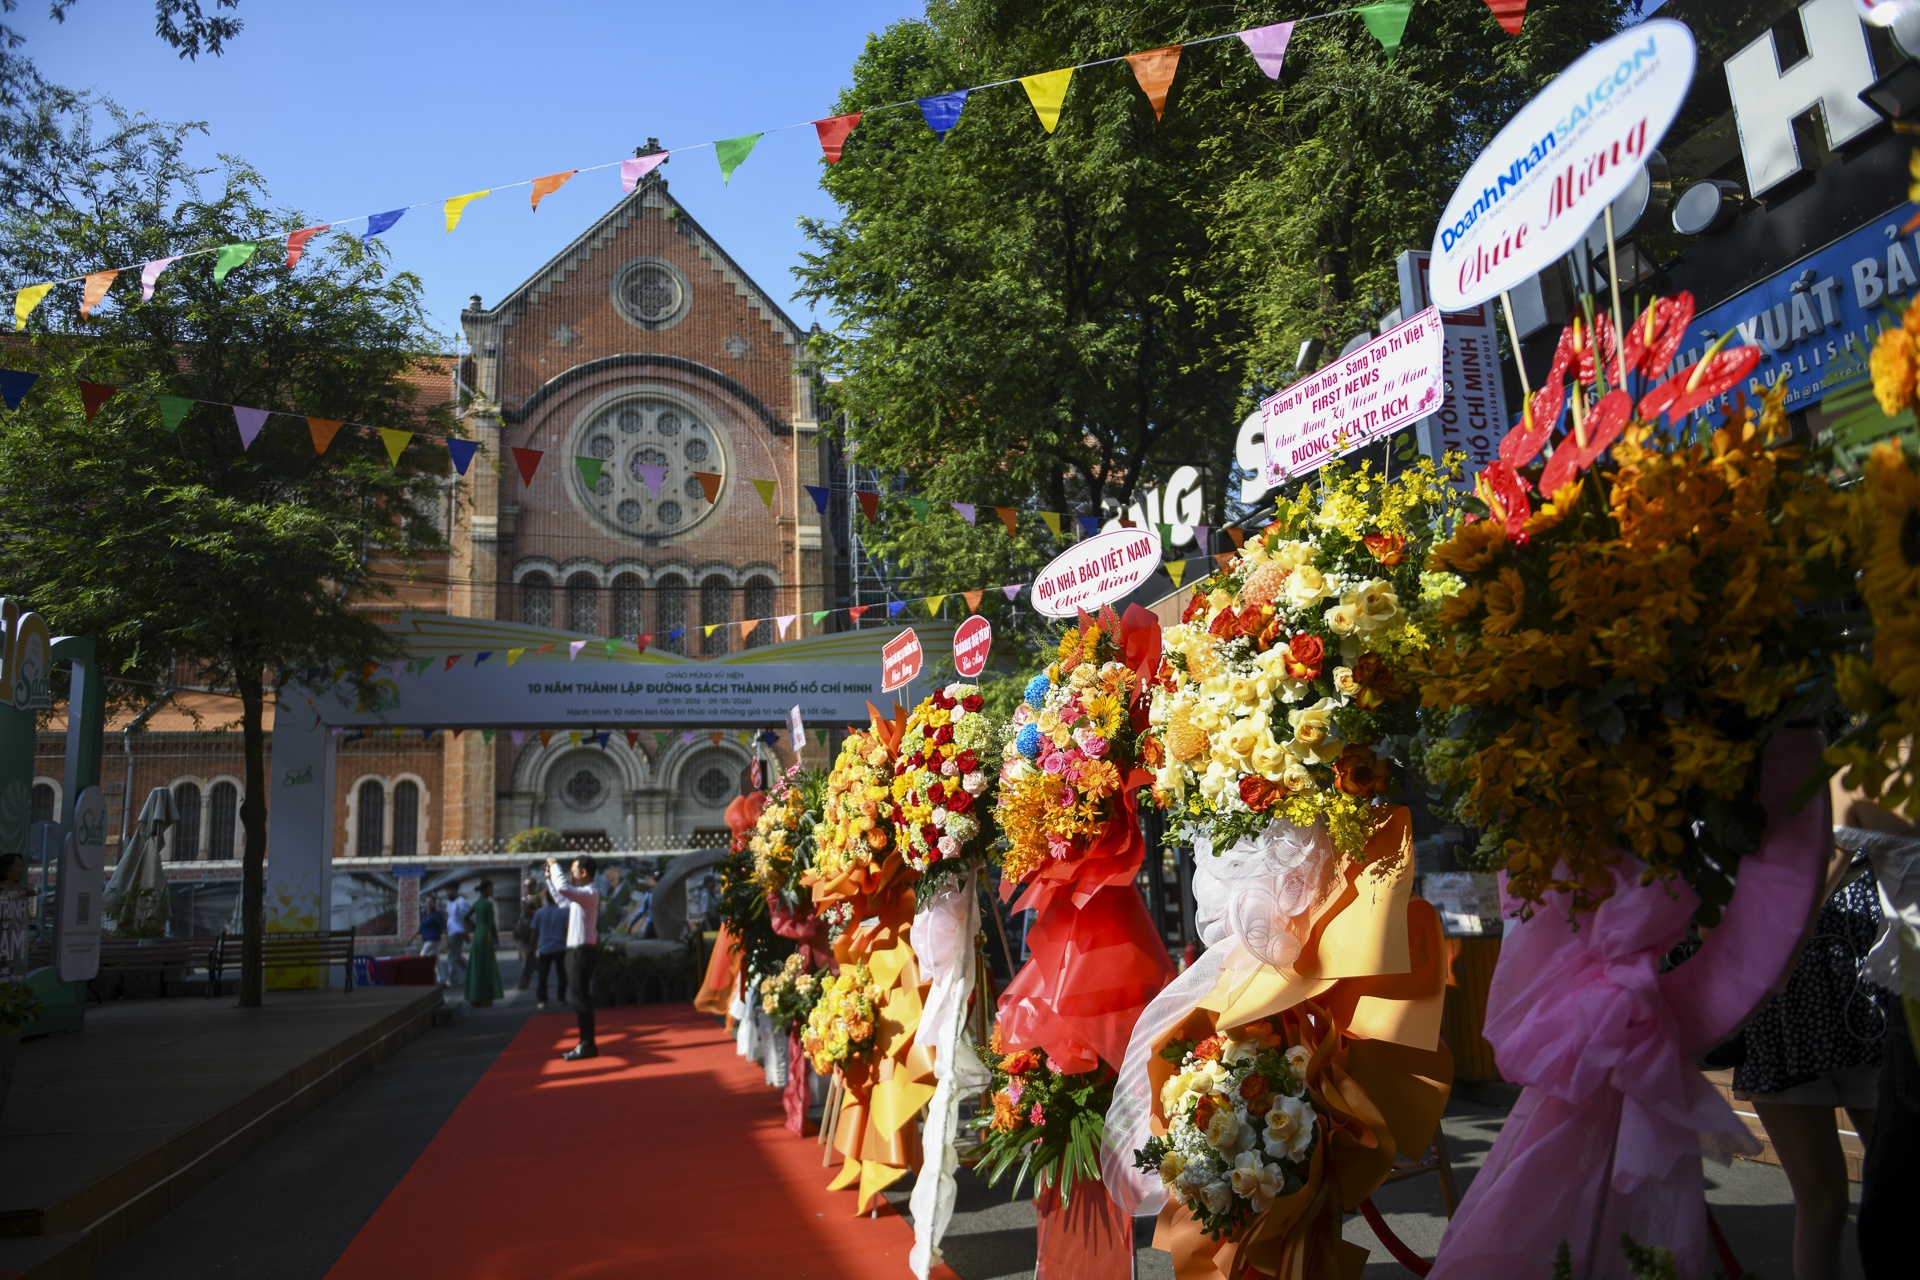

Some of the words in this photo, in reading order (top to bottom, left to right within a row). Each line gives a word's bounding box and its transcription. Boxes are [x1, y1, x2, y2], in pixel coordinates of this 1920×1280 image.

[1459, 221, 1531, 295] Chúc
[1541, 117, 1648, 231] Mừng
[1736, 268, 1841, 358] XUẤT
[1273, 397, 1294, 416] Công
[1294, 391, 1303, 405] ty
[1304, 381, 1320, 399] Văn
[1346, 357, 1369, 378] Sáng
[1370, 346, 1387, 364] Tạo
[1389, 336, 1402, 354] Trí
[1403, 323, 1425, 345] Việt
[1459, 337, 1481, 392] MINH
[1482, 334, 1493, 367] HOUSE
[1312, 391, 1343, 414] FIRST
[1345, 368, 1380, 397] NEWS
[1383, 382, 1395, 395] 10
[1487, 373, 1501, 437] PUBLISHING
[1291, 433, 1330, 466] ĐƯỜNG
[1331, 419, 1362, 445] SÁCH
[1363, 408, 1380, 429] TP.
[1381, 394, 1409, 423] HCM
[1463, 394, 1486, 430] CHÍ
[1038, 578, 1056, 600] HỘI
[1057, 566, 1077, 593] NHÀ
[1079, 557, 1100, 587] BÁO
[1101, 547, 1126, 573] VIỆT
[1127, 537, 1152, 563] NAM
[1054, 590, 1090, 611] Chúc
[527, 683, 542, 694] 10
[544, 681, 573, 694] NĂM
[576, 681, 618, 694] THÀNH
[621, 682, 643, 697] LẬP
[646, 681, 692, 694] ĐƯỜNG
[695, 681, 728, 694] SÁCH
[730, 682, 770, 694] THÀNH
[773, 680, 798, 694] PHỐ
[801, 680, 818, 694] HỒ
[820, 681, 841, 694] CHÍ
[843, 683, 873, 694] MINH
[665, 670, 688, 680] CHÀO
[690, 669, 712, 680] MỪNG
[613, 708, 623, 716] 10
